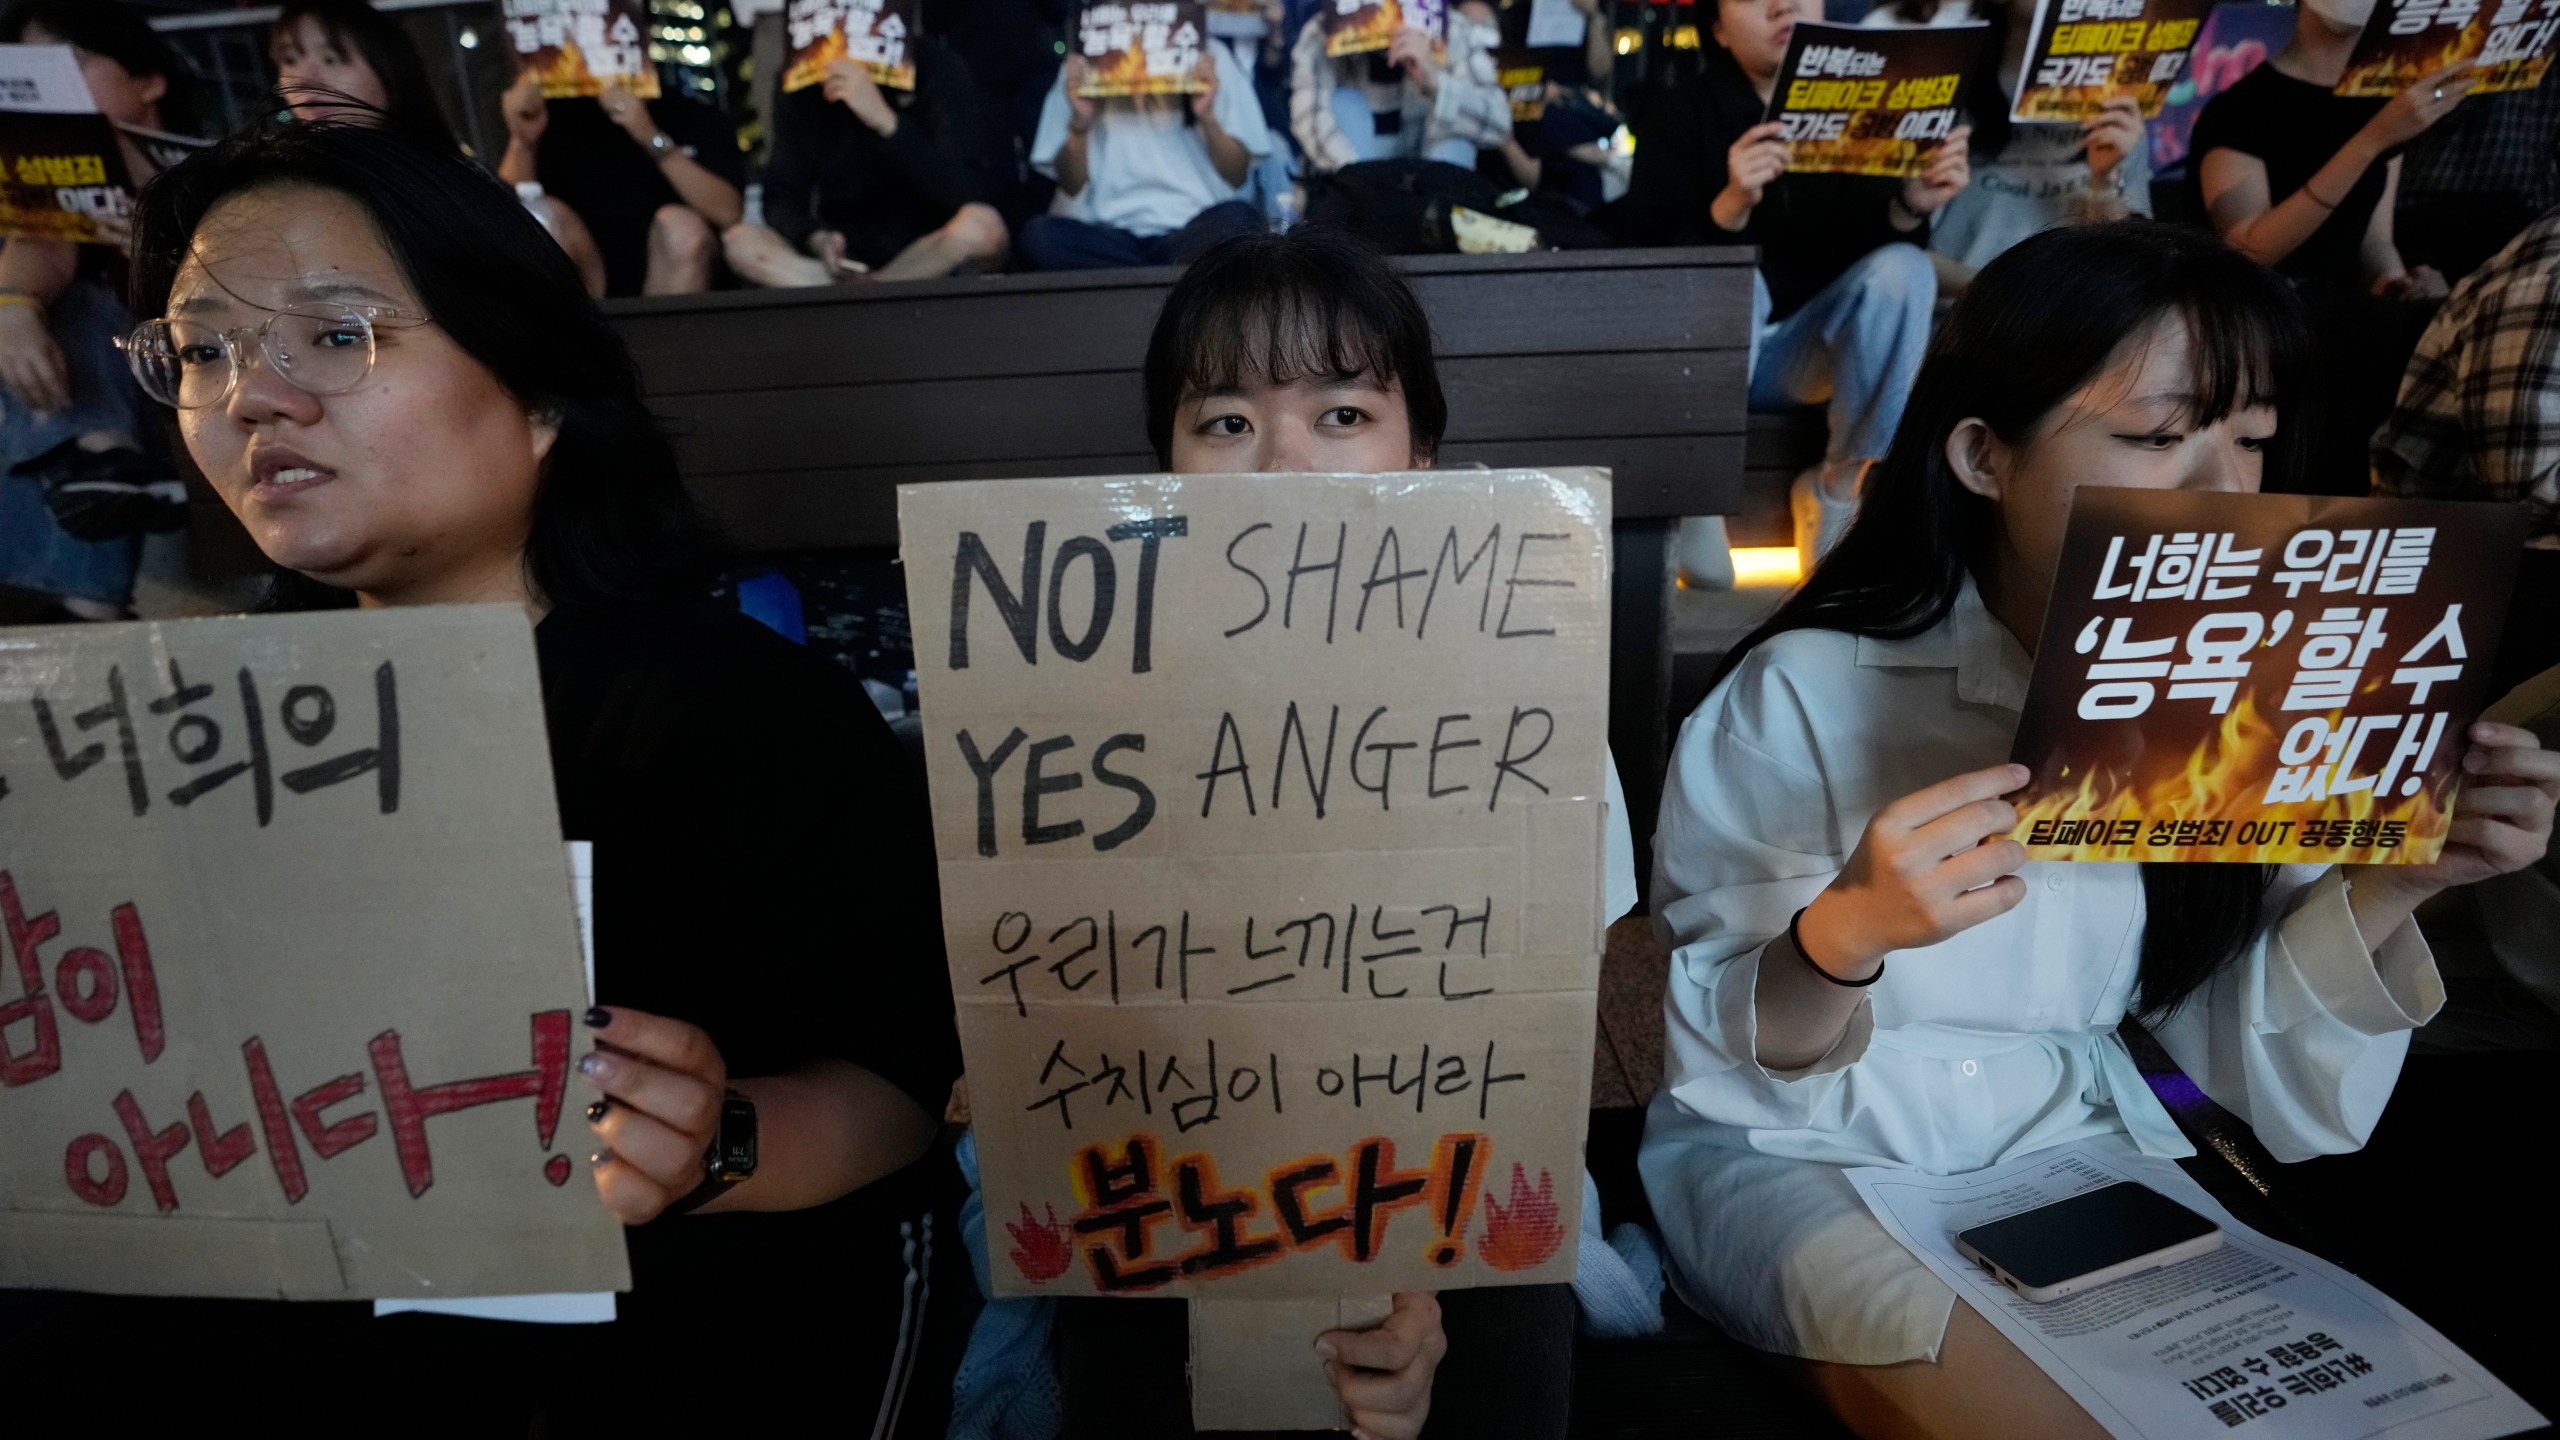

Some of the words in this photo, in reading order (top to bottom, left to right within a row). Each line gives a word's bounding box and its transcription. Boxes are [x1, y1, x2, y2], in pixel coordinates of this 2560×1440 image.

[2049, 20, 2147, 55] 딥페이크
[1796, 43, 1888, 78] 반복되는
[2036, 54, 2115, 87] 국가도
[1784, 78, 1889, 110] 딥페이크
[1886, 73, 1961, 110] 성범죄
[1778, 111, 1850, 142] 국가도
[16, 154, 108, 187] 성범죄
[2092, 531, 2264, 602] 너희는
[2272, 526, 2437, 599] 우리를
[949, 516, 1188, 673] NOT
[1224, 521, 1576, 644] SHAME
[2390, 603, 2468, 706] 수
[32, 656, 401, 828] 너희의
[2261, 711, 2450, 805] 없다!
[955, 726, 1158, 857] YES
[1195, 700, 1556, 820] ANGER
[2026, 819, 2140, 847] 딥페이크
[2145, 818, 2233, 848] 성범죄
[2235, 820, 2297, 847] OUT
[2297, 818, 2409, 849] 공동행동
[980, 909, 1216, 1018] 우리가
[1227, 897, 1494, 1000] 느끼는건
[1026, 1037, 1283, 1133] 수치심이
[1317, 1040, 1526, 1120] 아니라
[64, 1008, 573, 1214] 아니다!
[1073, 1133, 1490, 1291] 분노다!
[2240, 1356, 2271, 1377] 수
[2264, 1331, 2345, 1370] 능욕할
[2179, 1364, 2250, 1402] 없다!
[2277, 1352, 2375, 1397] #너희는
[2206, 1384, 2289, 1429] 우리를
